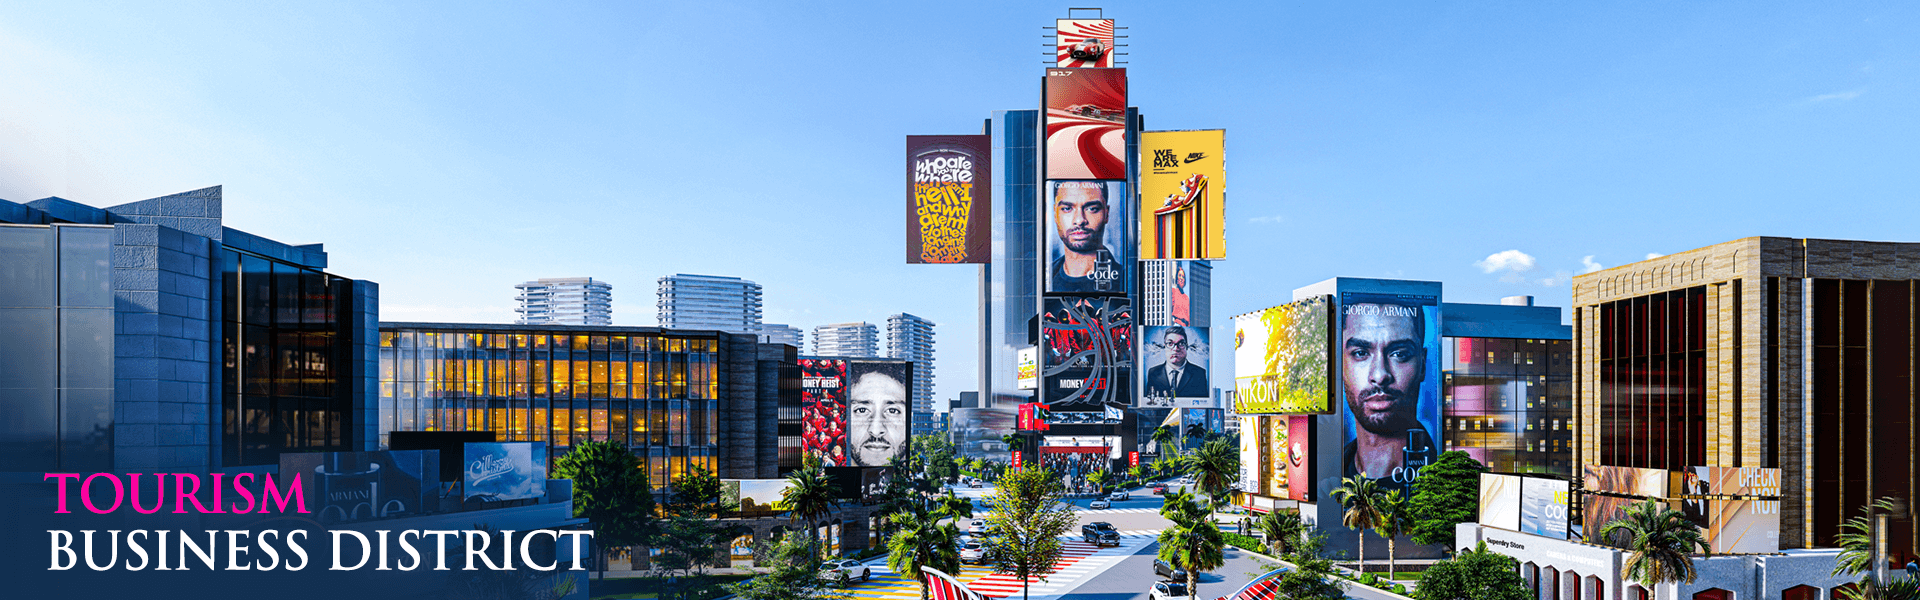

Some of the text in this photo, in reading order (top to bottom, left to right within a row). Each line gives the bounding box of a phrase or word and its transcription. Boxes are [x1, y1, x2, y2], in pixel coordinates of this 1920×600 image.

[916, 156, 972, 174] who are
[1154, 160, 1179, 168] MAX
[915, 169, 973, 187] where
[915, 185, 960, 207] hell
[917, 201, 972, 217] and why
[919, 212, 947, 227] are
[921, 224, 966, 238] clothes
[1087, 264, 1119, 280] code
[1342, 304, 1417, 318] GIORGIO ARMANI
[802, 379, 839, 388] ONEY HEIST
[1060, 379, 1084, 388] MONEY
[1236, 380, 1277, 404] NIKON
[1738, 467, 1776, 487] CHECK
[1510, 541, 1525, 550] Store
